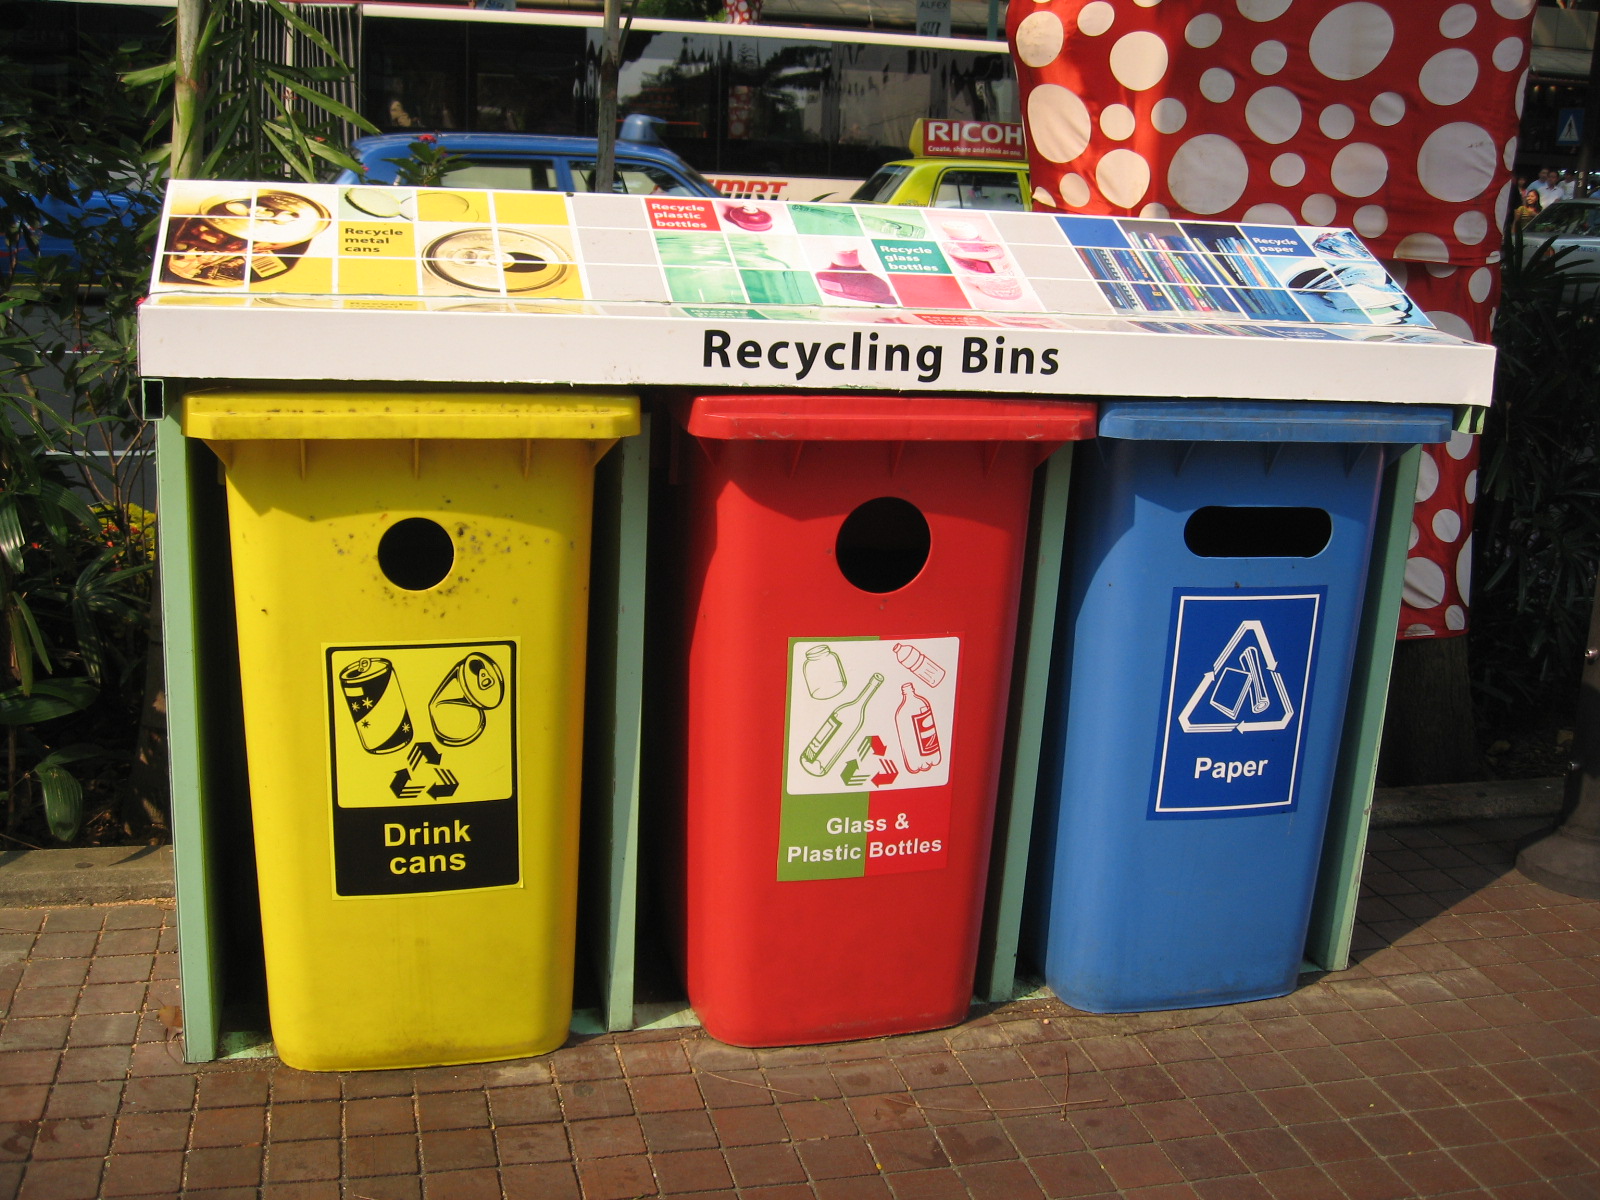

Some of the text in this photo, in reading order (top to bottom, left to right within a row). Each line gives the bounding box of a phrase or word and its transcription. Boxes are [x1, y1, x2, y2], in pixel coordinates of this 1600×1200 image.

[928, 121, 1022, 146] RICOH
[953, 145, 971, 153] share
[706, 178, 788, 201] MRT
[652, 203, 705, 212] Recycle
[654, 211, 701, 220] plastic
[656, 219, 708, 229] bottles
[344, 227, 404, 237] Recycle
[344, 237, 390, 245] metal
[1251, 237, 1299, 246] Recycle
[879, 245, 933, 256] Recycle
[884, 253, 921, 263] glass
[888, 262, 939, 272] bottles
[702, 329, 1060, 383] Recycling Bins
[1194, 757, 1269, 784] Paper
[826, 812, 909, 835] Glass &
[384, 819, 472, 847] Drink
[787, 838, 942, 863] Plastic Bottles
[389, 852, 467, 875] cans
